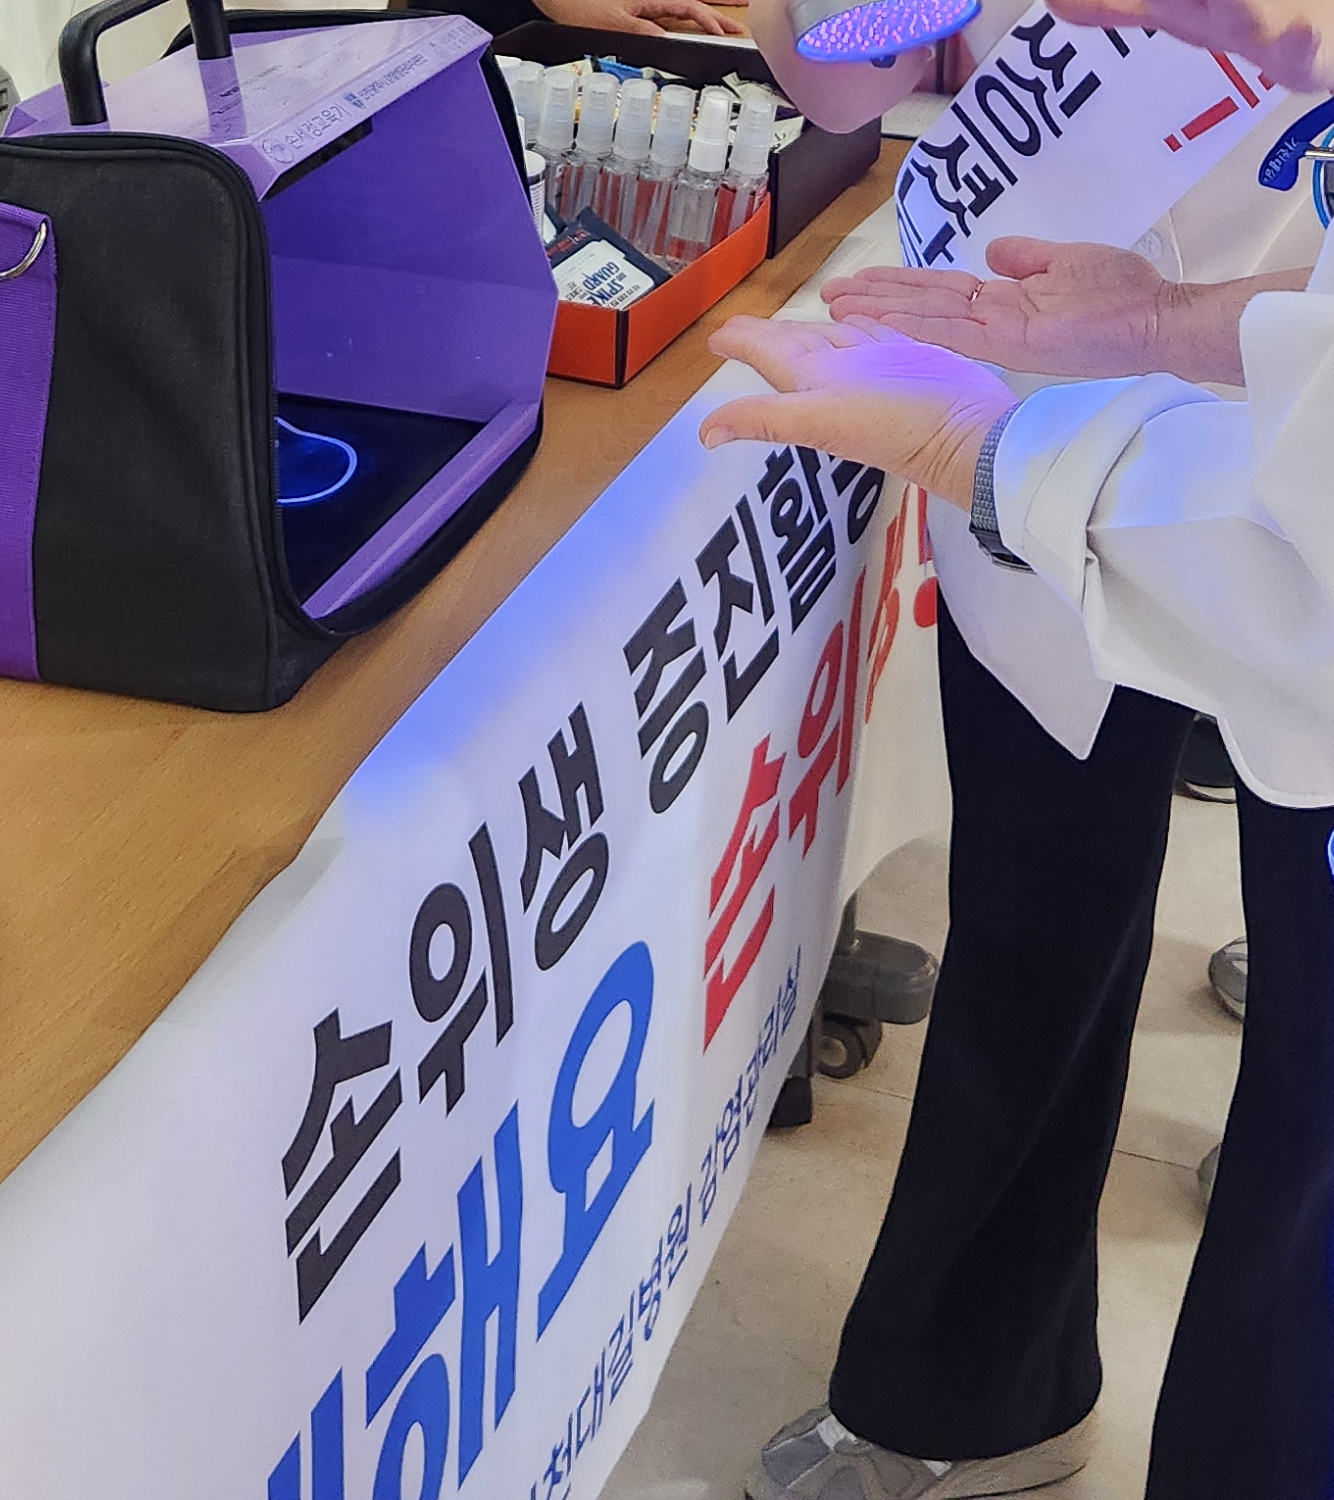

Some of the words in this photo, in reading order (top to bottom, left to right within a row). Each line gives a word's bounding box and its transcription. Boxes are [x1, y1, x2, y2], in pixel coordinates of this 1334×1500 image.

[582, 261, 621, 291] GUARD
[587, 276, 625, 306] SPIKE
[282, 702, 610, 1324] 손위생
[698, 944, 802, 1227] 감염관리실
